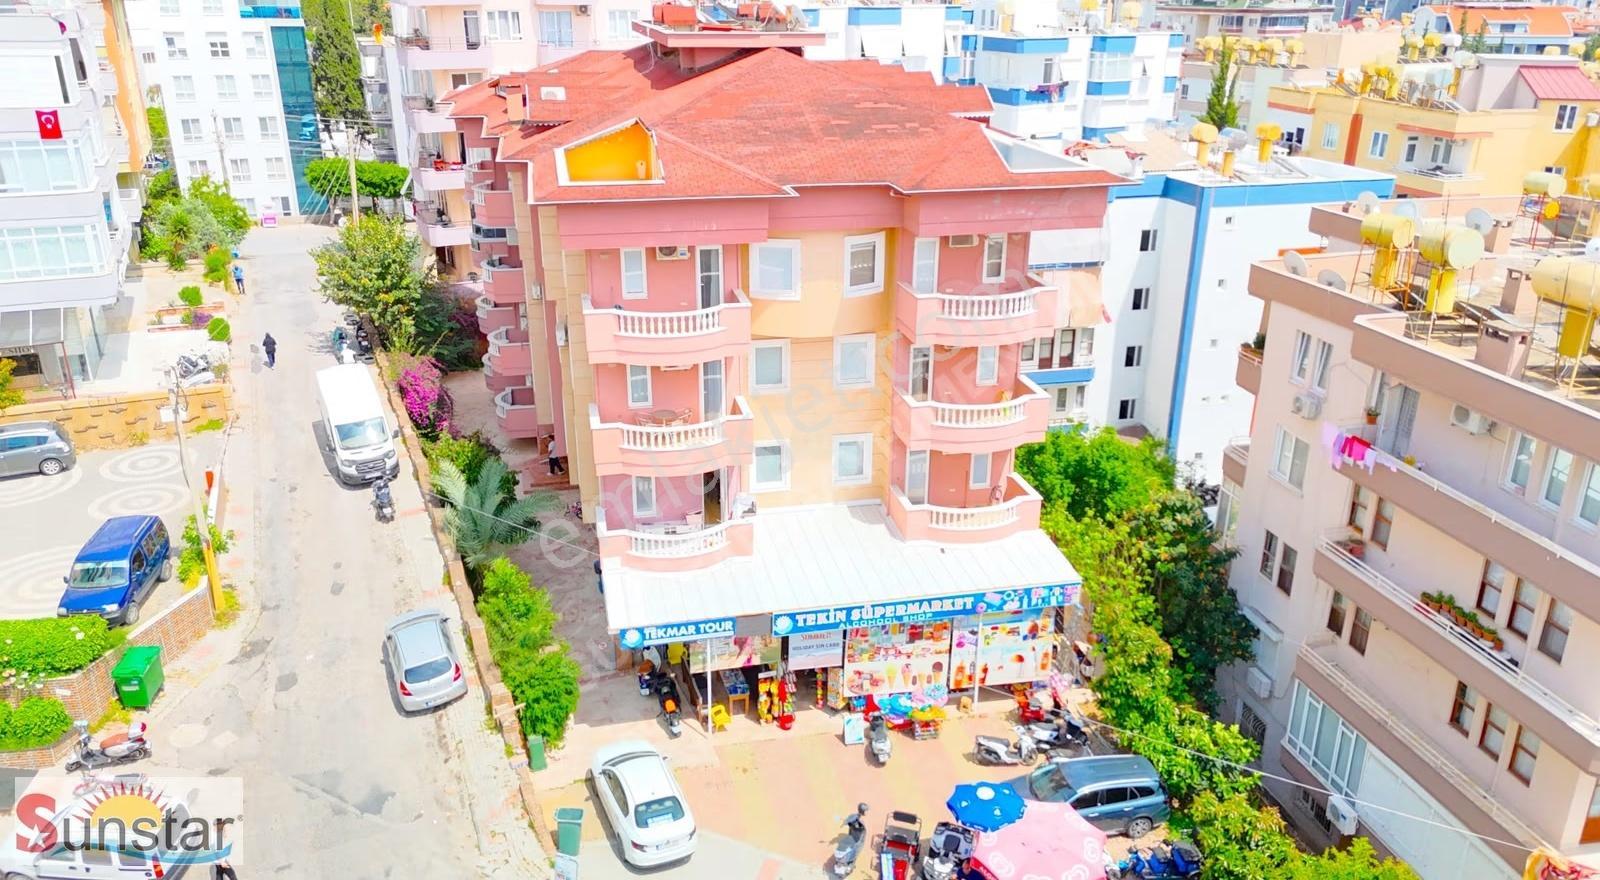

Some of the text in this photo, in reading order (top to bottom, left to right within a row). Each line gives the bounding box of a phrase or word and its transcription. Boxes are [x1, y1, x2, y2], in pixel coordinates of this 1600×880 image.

[795, 597, 975, 627] TEKİN SÜPERMARKET
[902, 613, 933, 622] SHOP
[643, 620, 734, 640] TEKMAR TOUR
